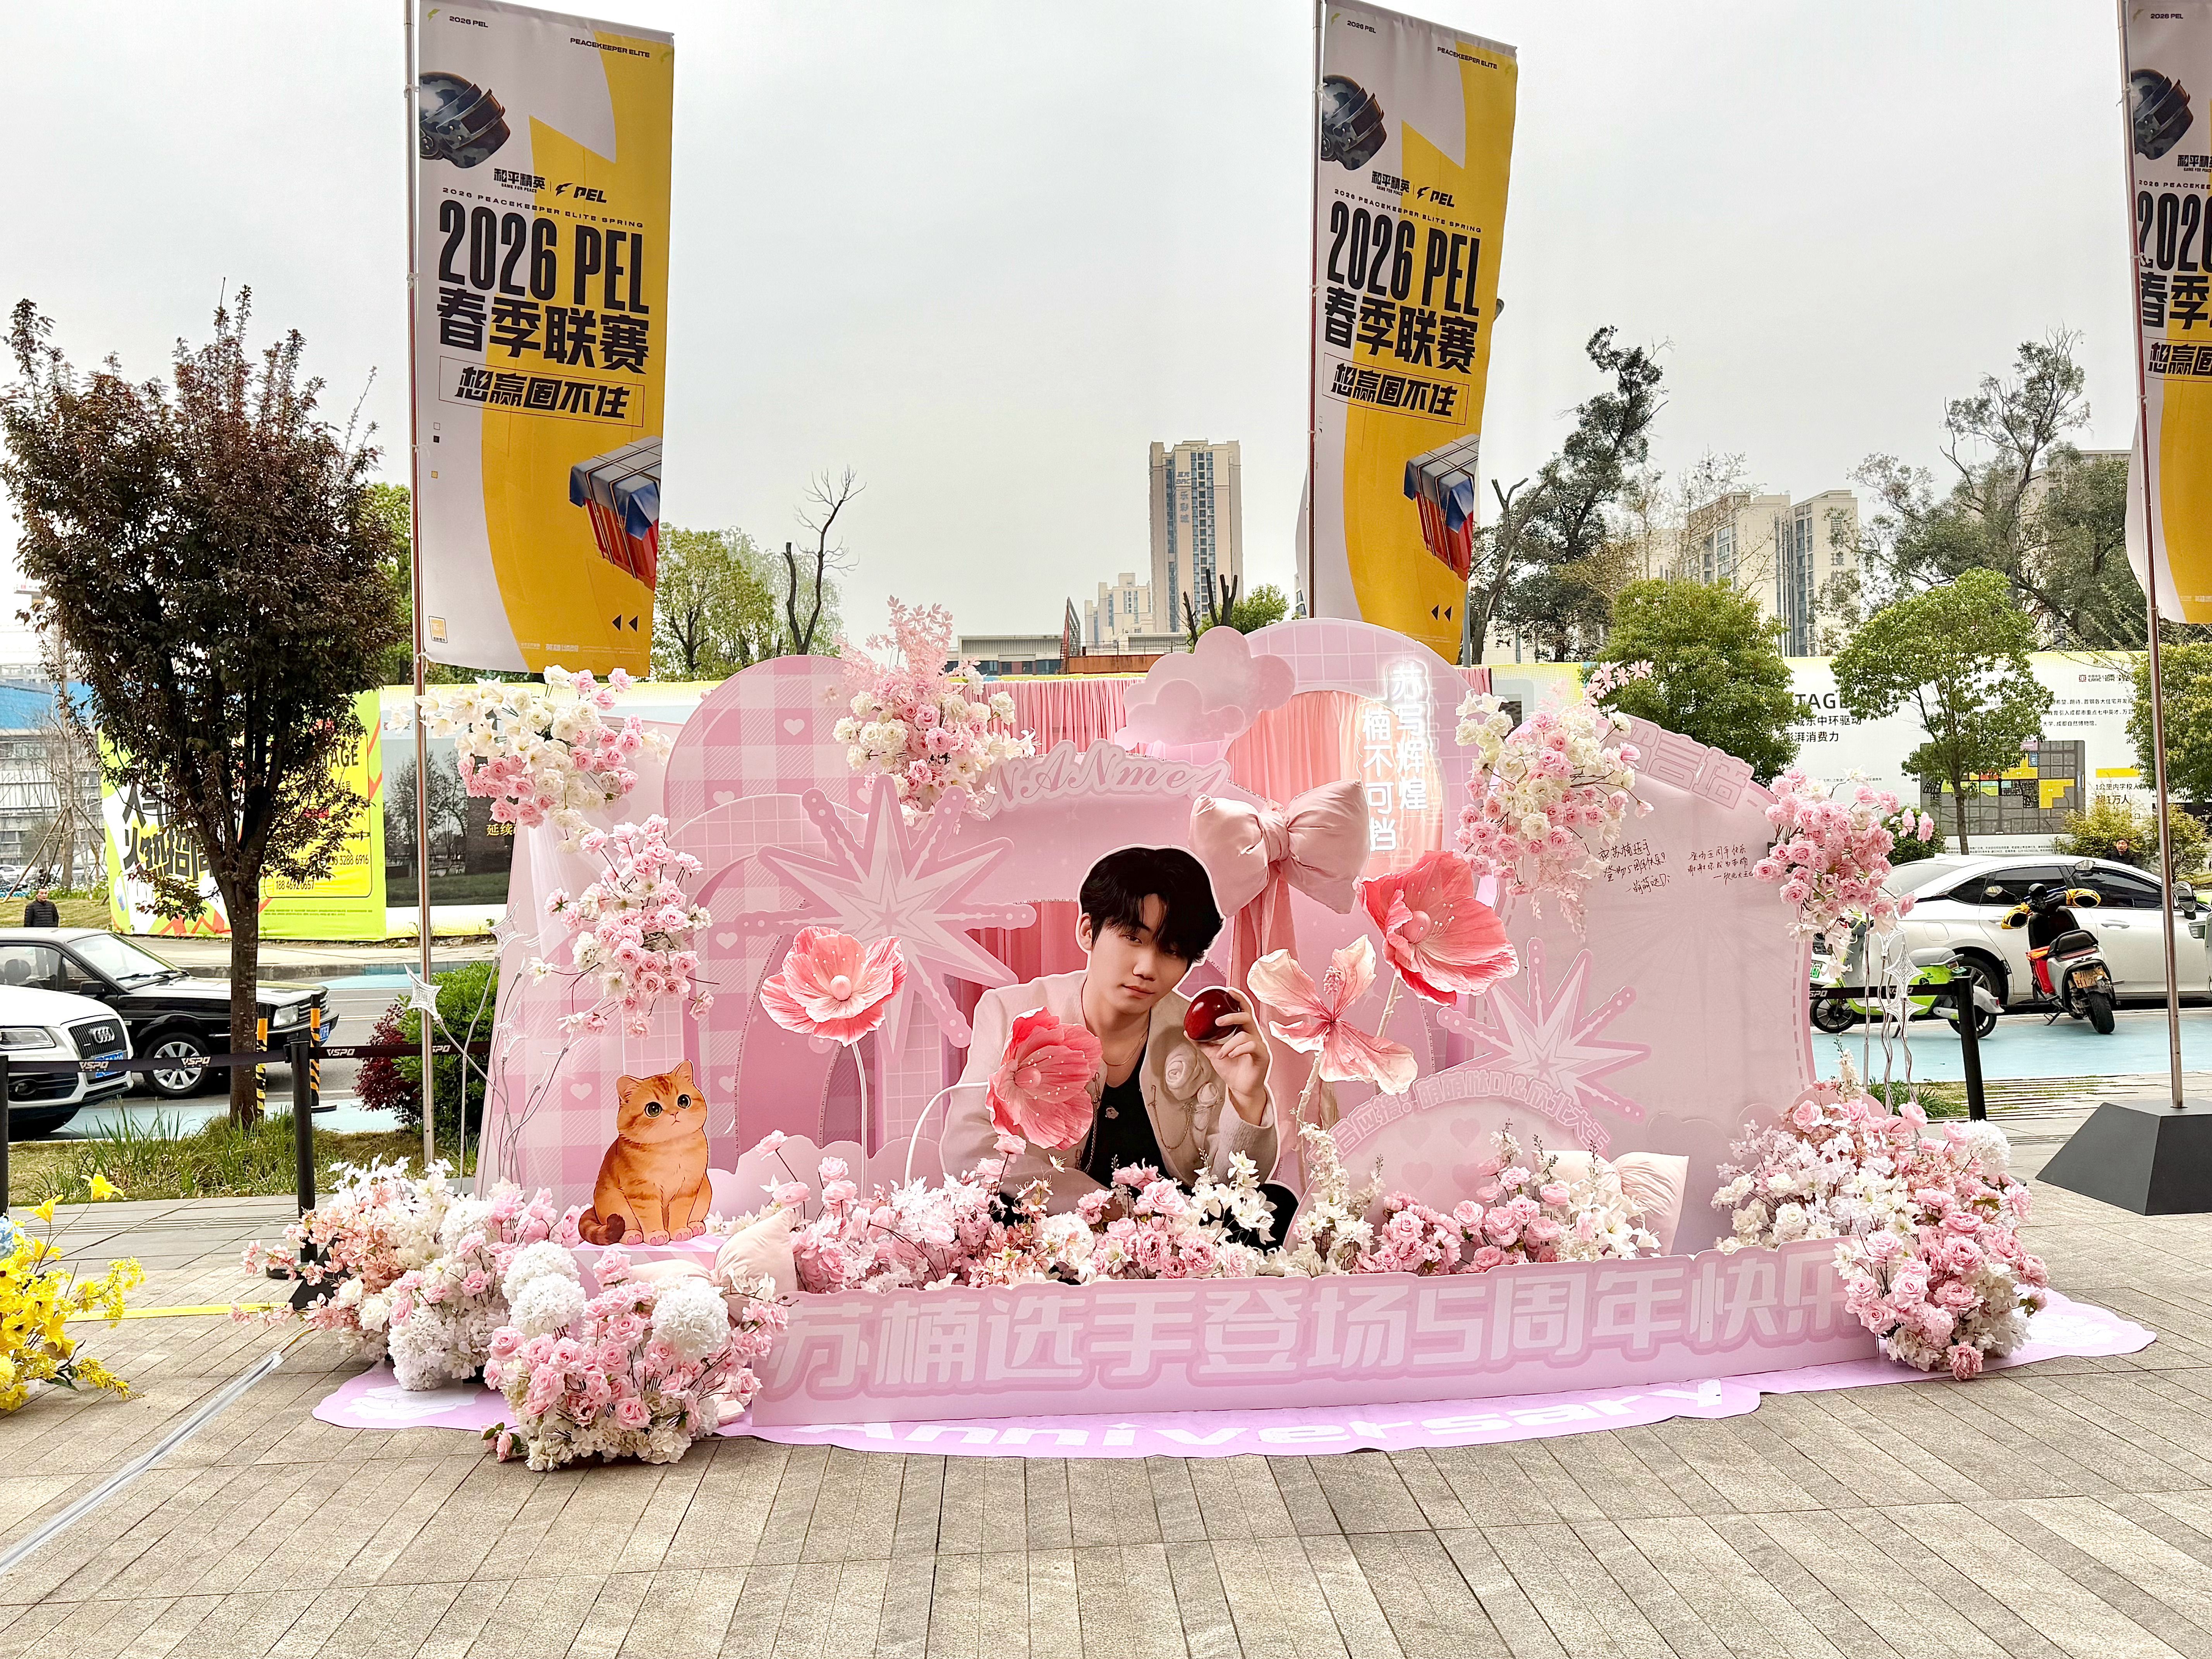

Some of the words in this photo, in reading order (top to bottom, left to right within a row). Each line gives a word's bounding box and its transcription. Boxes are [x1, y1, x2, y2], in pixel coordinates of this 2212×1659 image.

[449, 16, 471, 25] 2026
[1347, 20, 1364, 29] 2026
[1364, 26, 1376, 34] PEL
[570, 38, 628, 54] PEACEKEEPER
[629, 49, 650, 58] ELITE
[1437, 46, 1480, 65] PEACEKEEPER
[1481, 60, 1497, 69] ELITE
[494, 168, 545, 190] 和平精英
[574, 186, 607, 203] PEL
[1371, 170, 1410, 193] 和平精英
[1430, 191, 1455, 208] PEL
[443, 187, 472, 198] 2026
[478, 195, 560, 215] PEACEKEEPER
[565, 211, 596, 221] ELITE
[602, 217, 644, 228] SPRING
[1334, 189, 1355, 199] 2026
[1358, 196, 1419, 218] PEACEKEEPER
[1422, 214, 1446, 225] ELITE
[1449, 221, 1482, 233] SPRING
[439, 199, 557, 300] 2026
[574, 224, 649, 314] PEL
[1328, 201, 1415, 301] 2026
[1421, 227, 1480, 317] PEL
[2140, 272, 2212, 330] 春季
[437, 287, 649, 374] 春季联赛
[1325, 287, 1478, 374] 春季联赛
[454, 366, 630, 419] 想赢圈不住
[1331, 363, 1458, 417] 想赢圈不住
[1391, 665, 1428, 811] 苏写辉煌
[1361, 707, 1396, 852] 楠不可挡
[486, 823, 517, 836] 延续
[182, 1056, 211, 1066] VSPO
[326, 1048, 355, 1056] VSPO
[772, 1249, 1861, 1389] 苏楠选手登场5周年快乐
